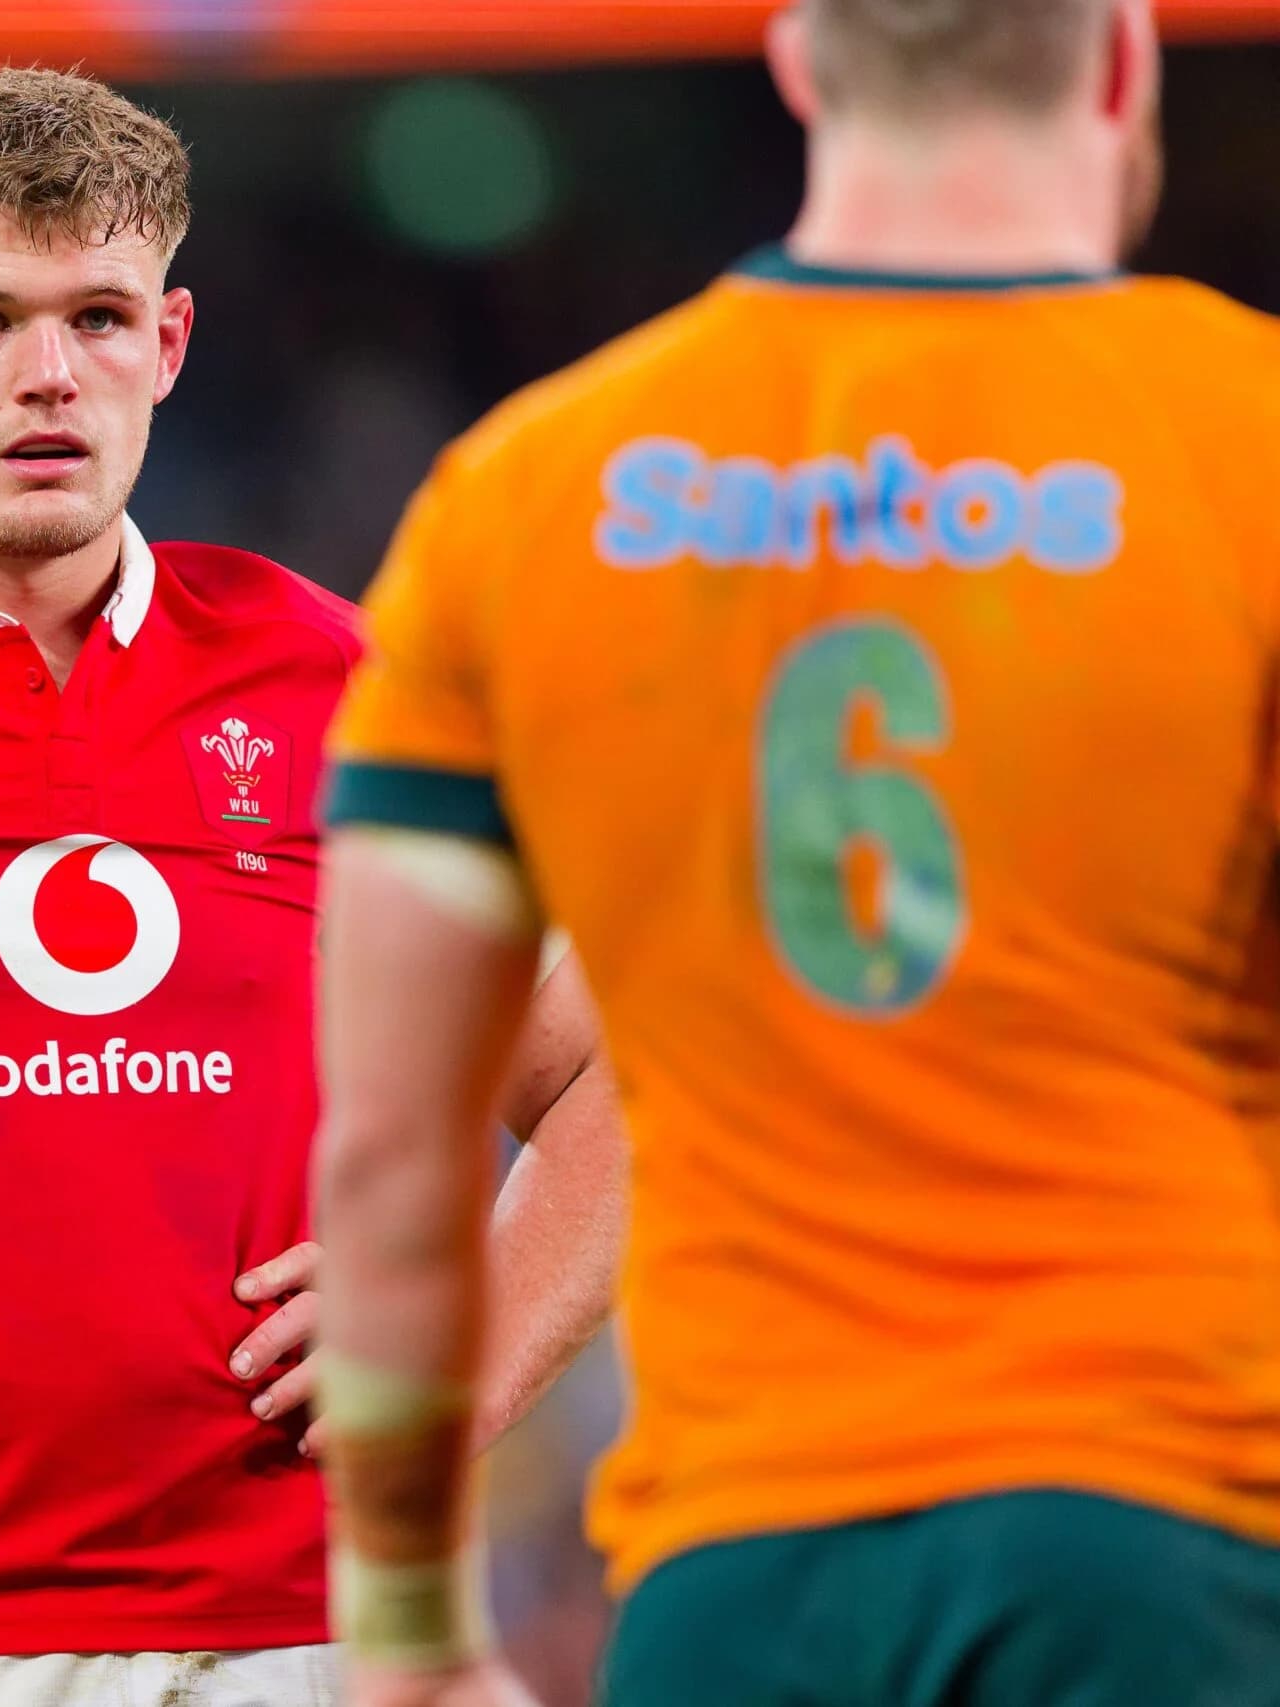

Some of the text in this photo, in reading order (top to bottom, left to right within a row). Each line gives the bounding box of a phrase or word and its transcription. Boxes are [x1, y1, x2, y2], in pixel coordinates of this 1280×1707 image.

[595, 435, 1123, 573] Santos
[228, 797, 260, 815] WRU
[754, 611, 970, 1024] 6
[235, 850, 268, 872] 1190
